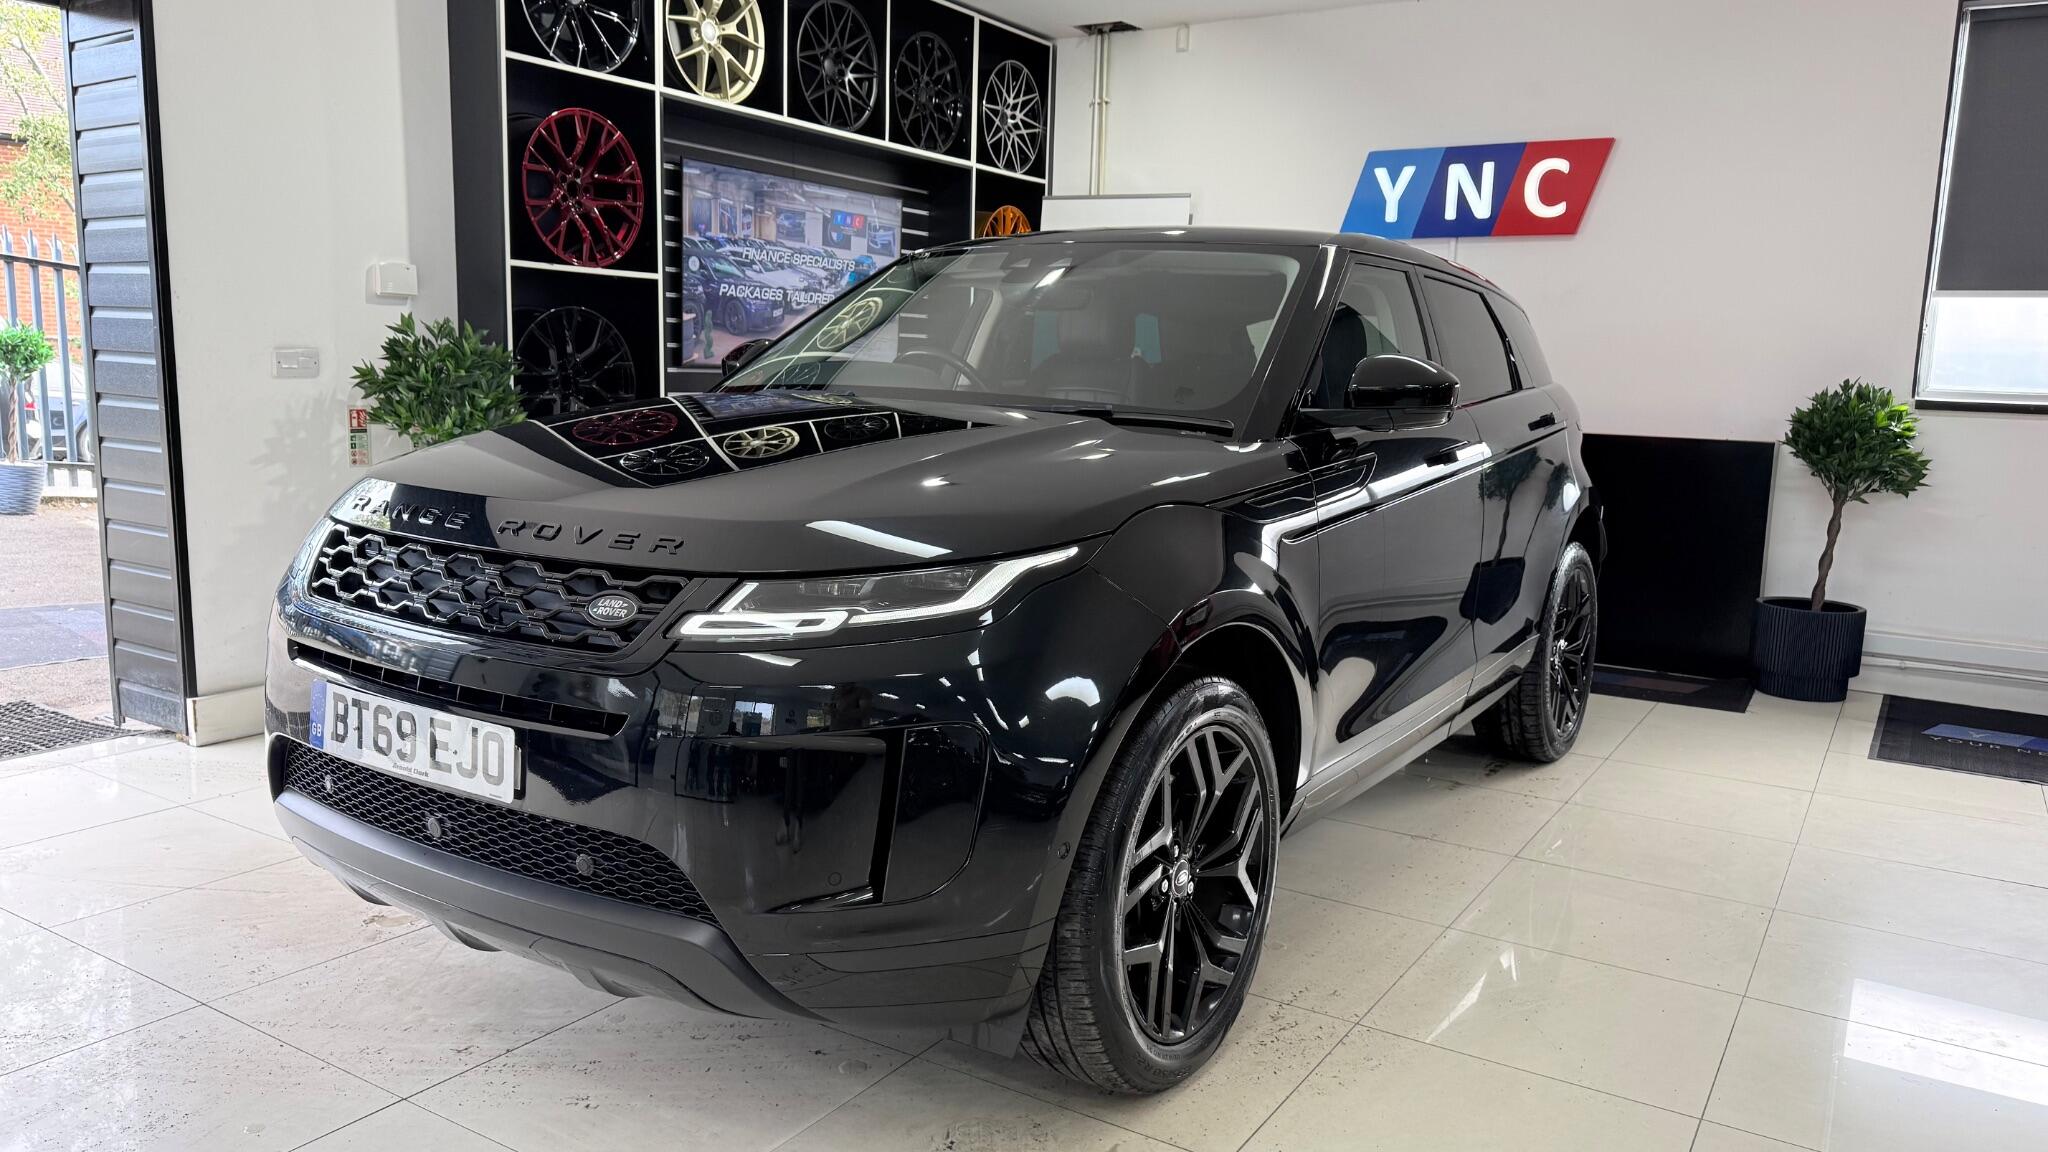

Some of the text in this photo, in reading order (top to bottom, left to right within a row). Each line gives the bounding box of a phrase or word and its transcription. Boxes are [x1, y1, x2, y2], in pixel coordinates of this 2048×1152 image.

[1374, 157, 1570, 223] YNC
[742, 247, 856, 271] FINANCE SPECIALISTS
[719, 283, 783, 300] PACKAGES
[351, 494, 684, 555] RANGE ROVER
[311, 721, 322, 737] GB
[330, 691, 417, 763] BT69
[1930, 735, 2000, 749] YOUR
